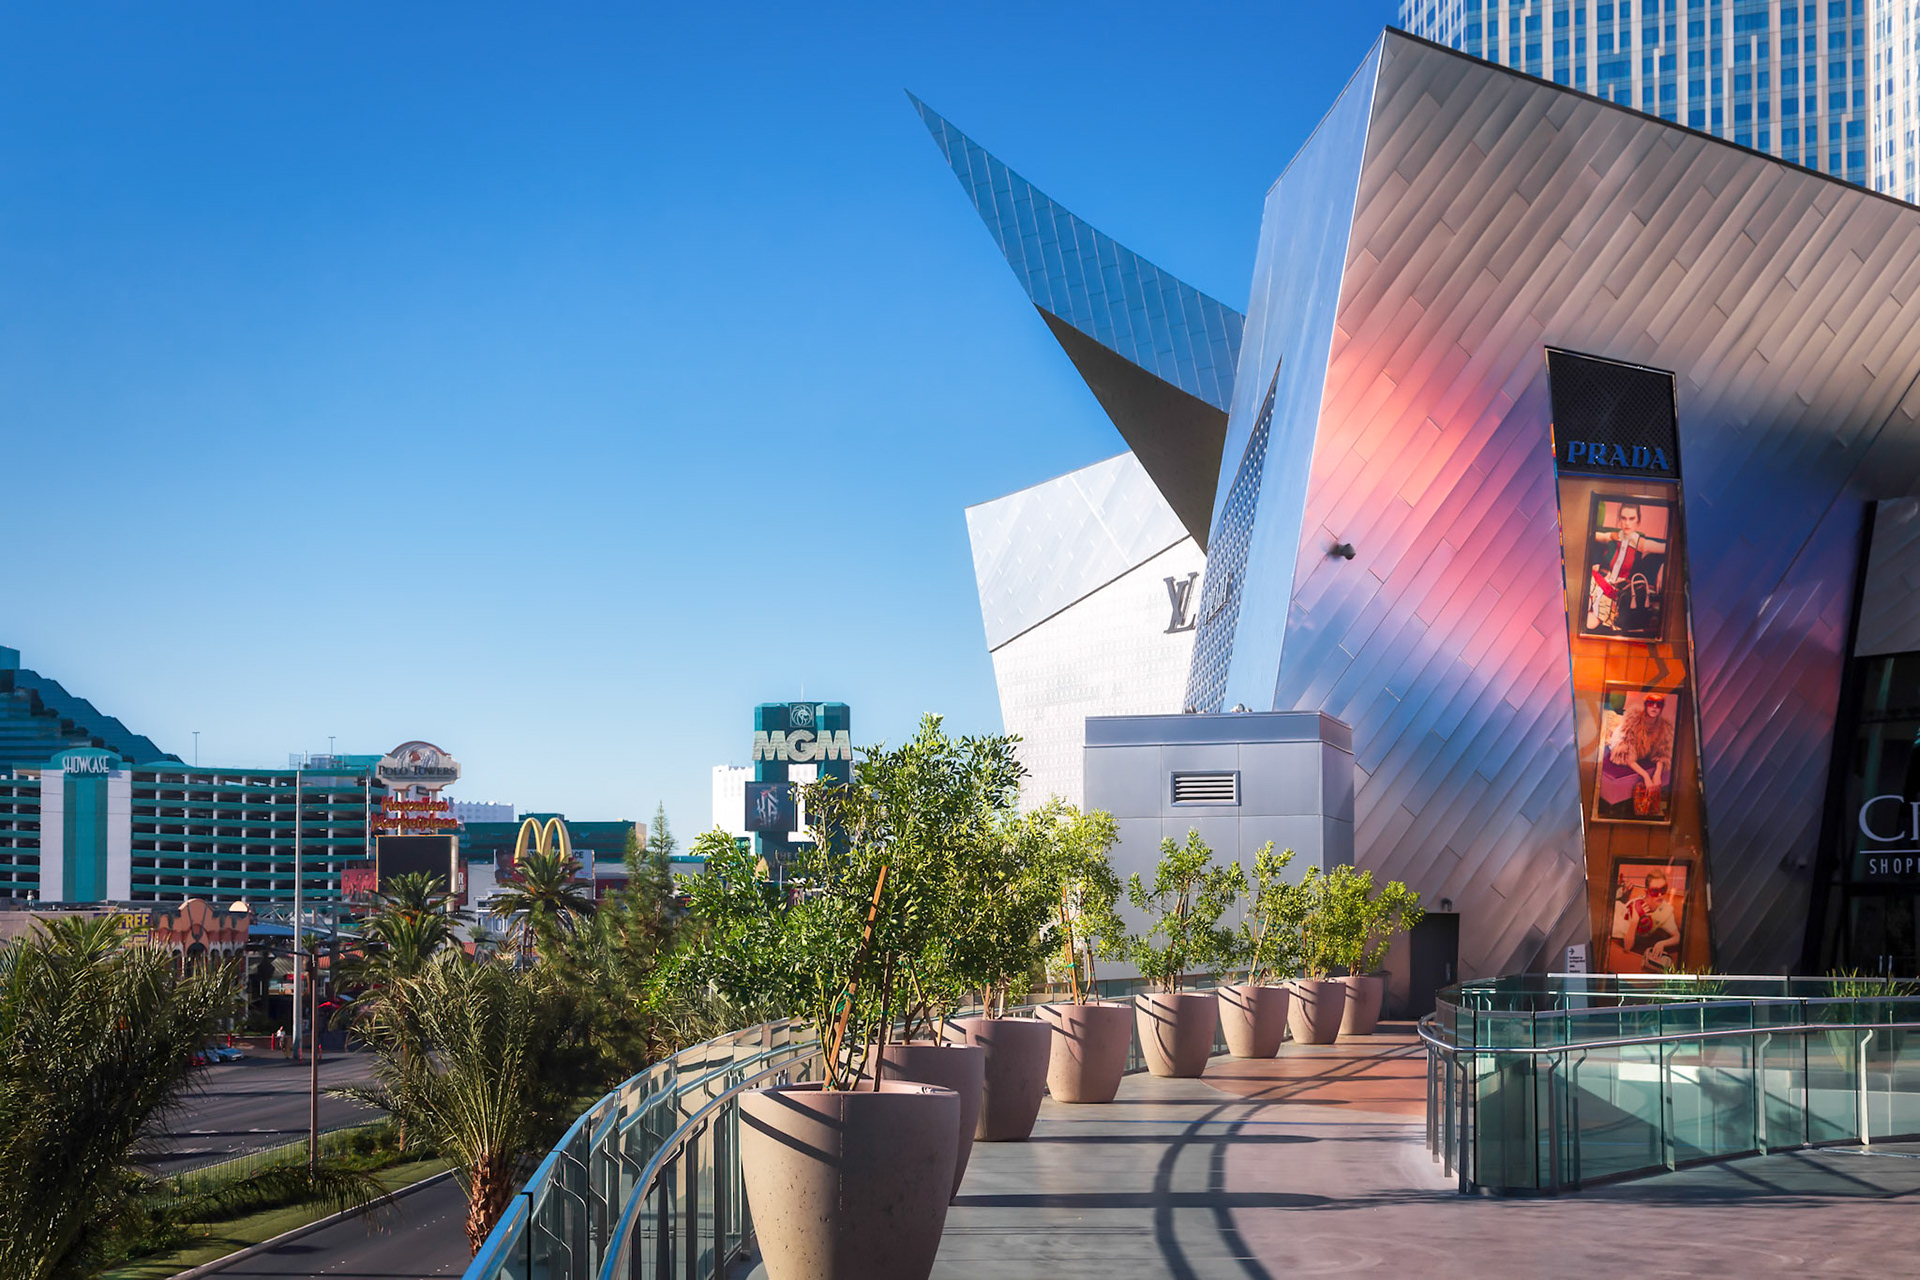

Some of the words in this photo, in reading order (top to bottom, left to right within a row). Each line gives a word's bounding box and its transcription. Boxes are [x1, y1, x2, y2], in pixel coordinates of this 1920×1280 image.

[1567, 440, 1669, 470] PRADA
[752, 729, 853, 762] MGM
[62, 755, 110, 774] SHOWCASE
[381, 796, 449, 812] Hawaiian
[370, 813, 458, 832] Marketplace
